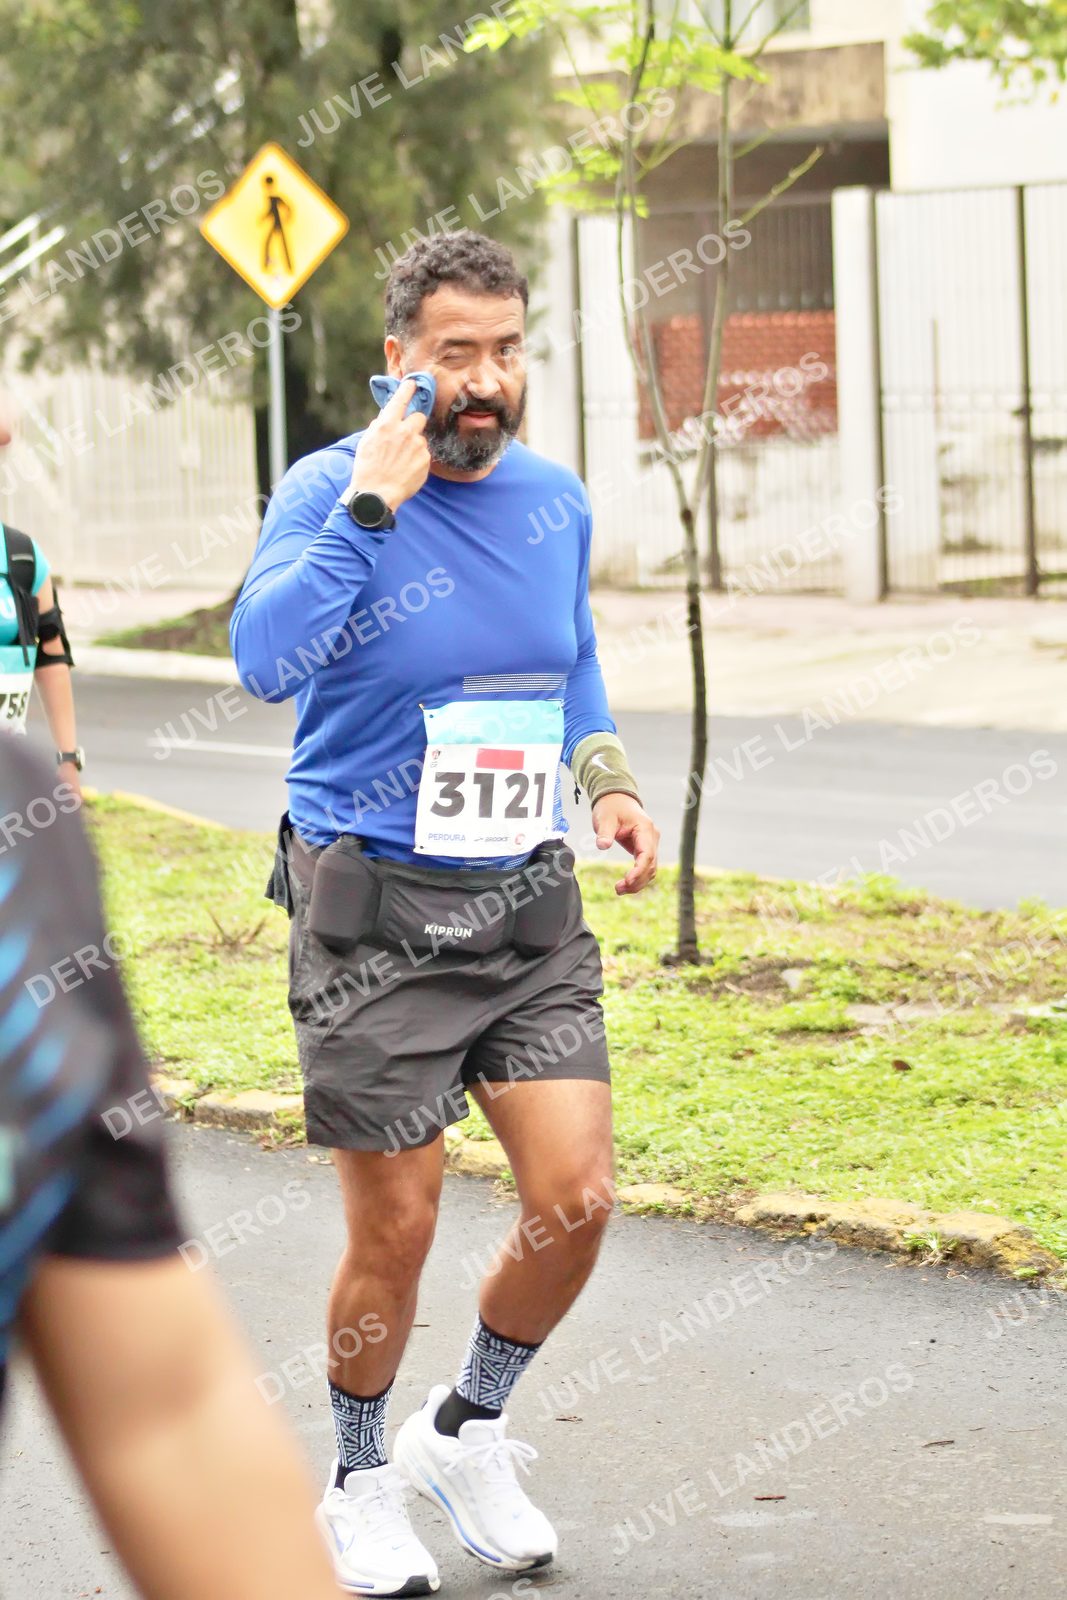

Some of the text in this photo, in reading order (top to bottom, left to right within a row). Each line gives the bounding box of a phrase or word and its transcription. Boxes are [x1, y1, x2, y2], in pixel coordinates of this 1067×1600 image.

[430, 771, 547, 819] 3121
[428, 832, 466, 842] PERDURA
[424, 924, 473, 938] KIPRUN
